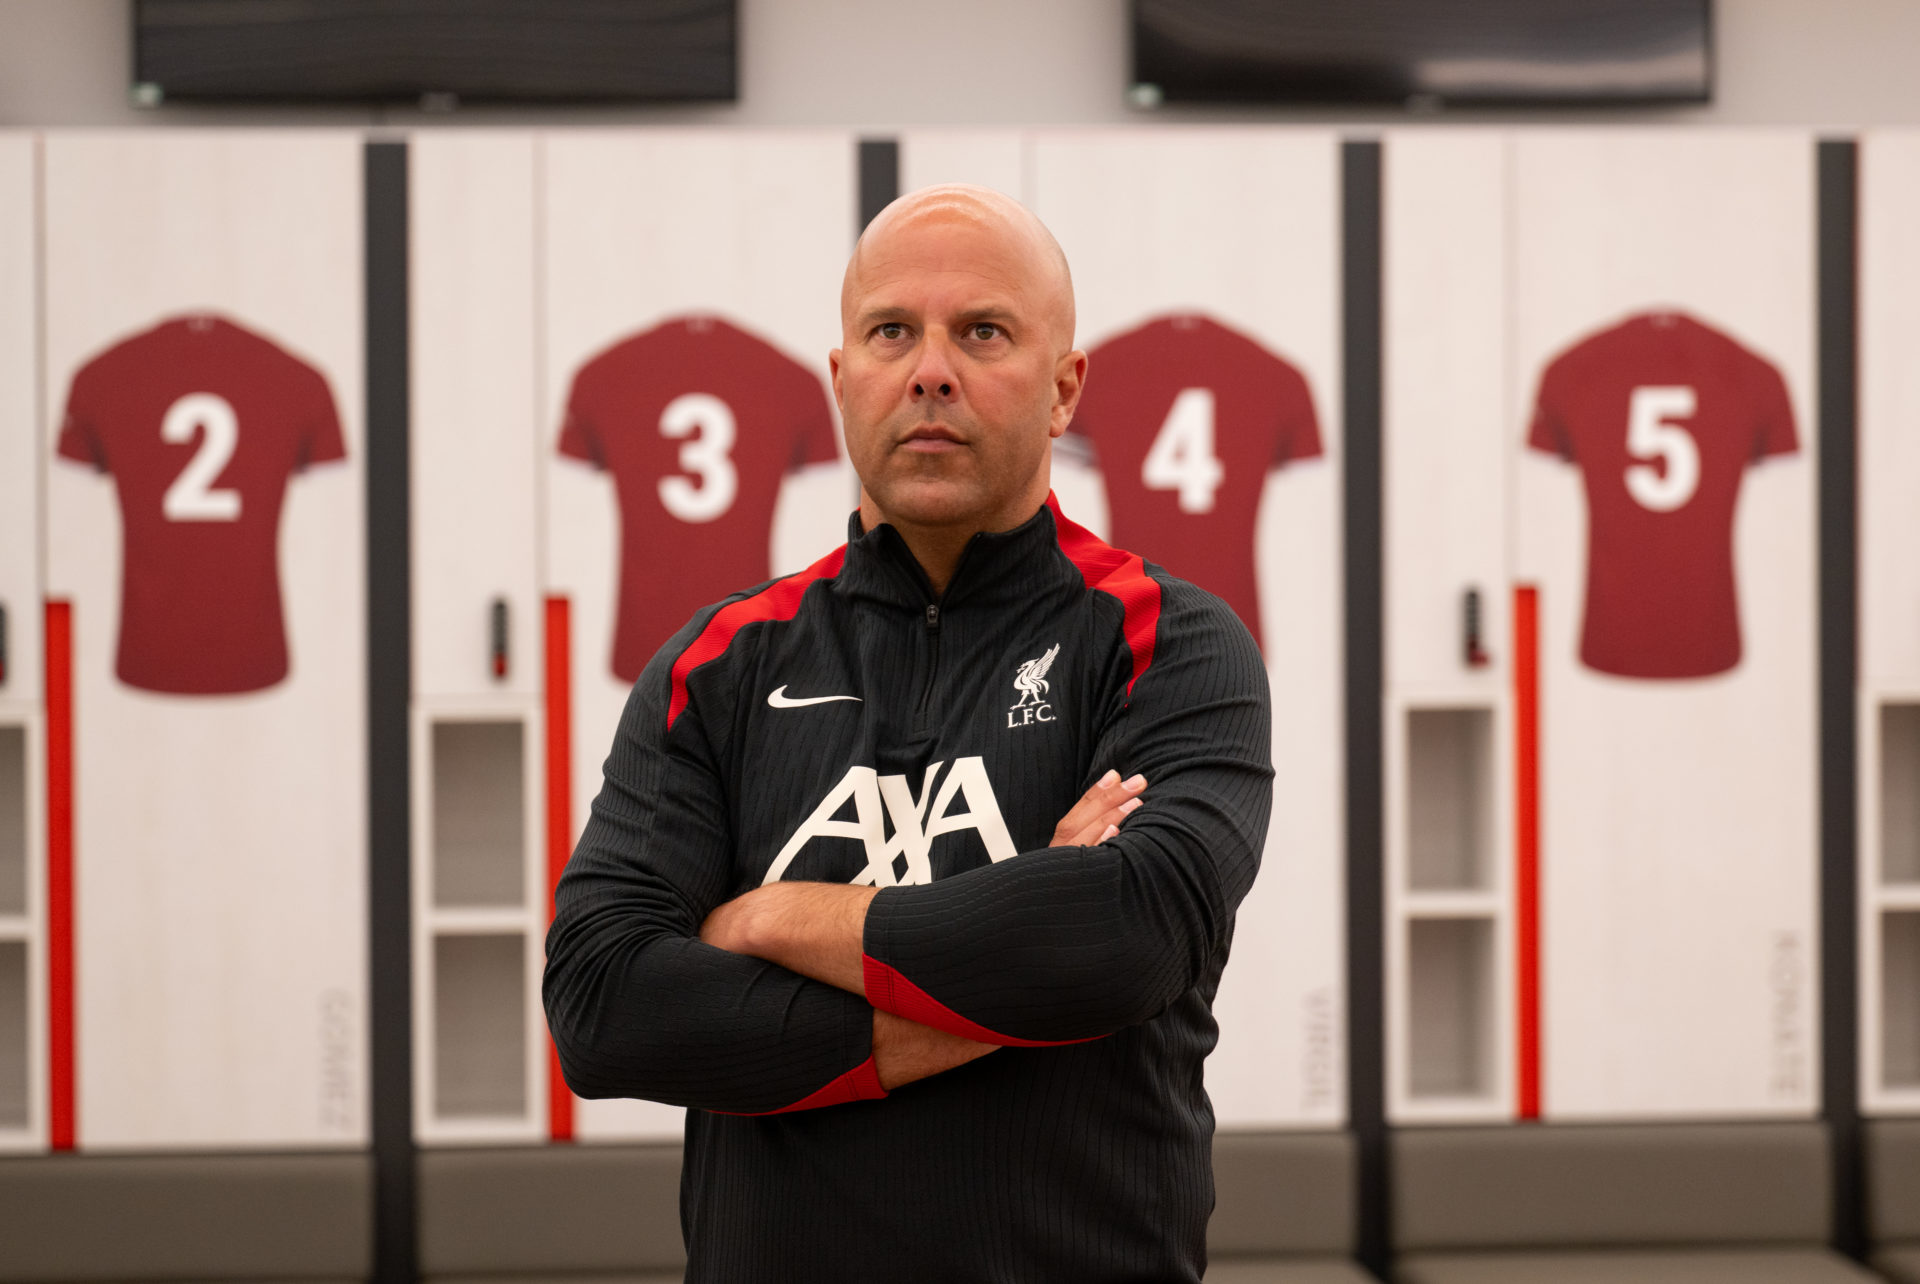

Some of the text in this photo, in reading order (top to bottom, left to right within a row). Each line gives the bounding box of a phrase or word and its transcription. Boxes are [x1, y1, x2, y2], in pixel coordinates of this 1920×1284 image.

[162, 394, 242, 521] 2
[659, 394, 737, 521] 3
[1143, 388, 1223, 513] 4
[1627, 386, 1699, 511] 5
[1007, 704, 1057, 729] L.F.C.
[761, 756, 1018, 887] AXA
